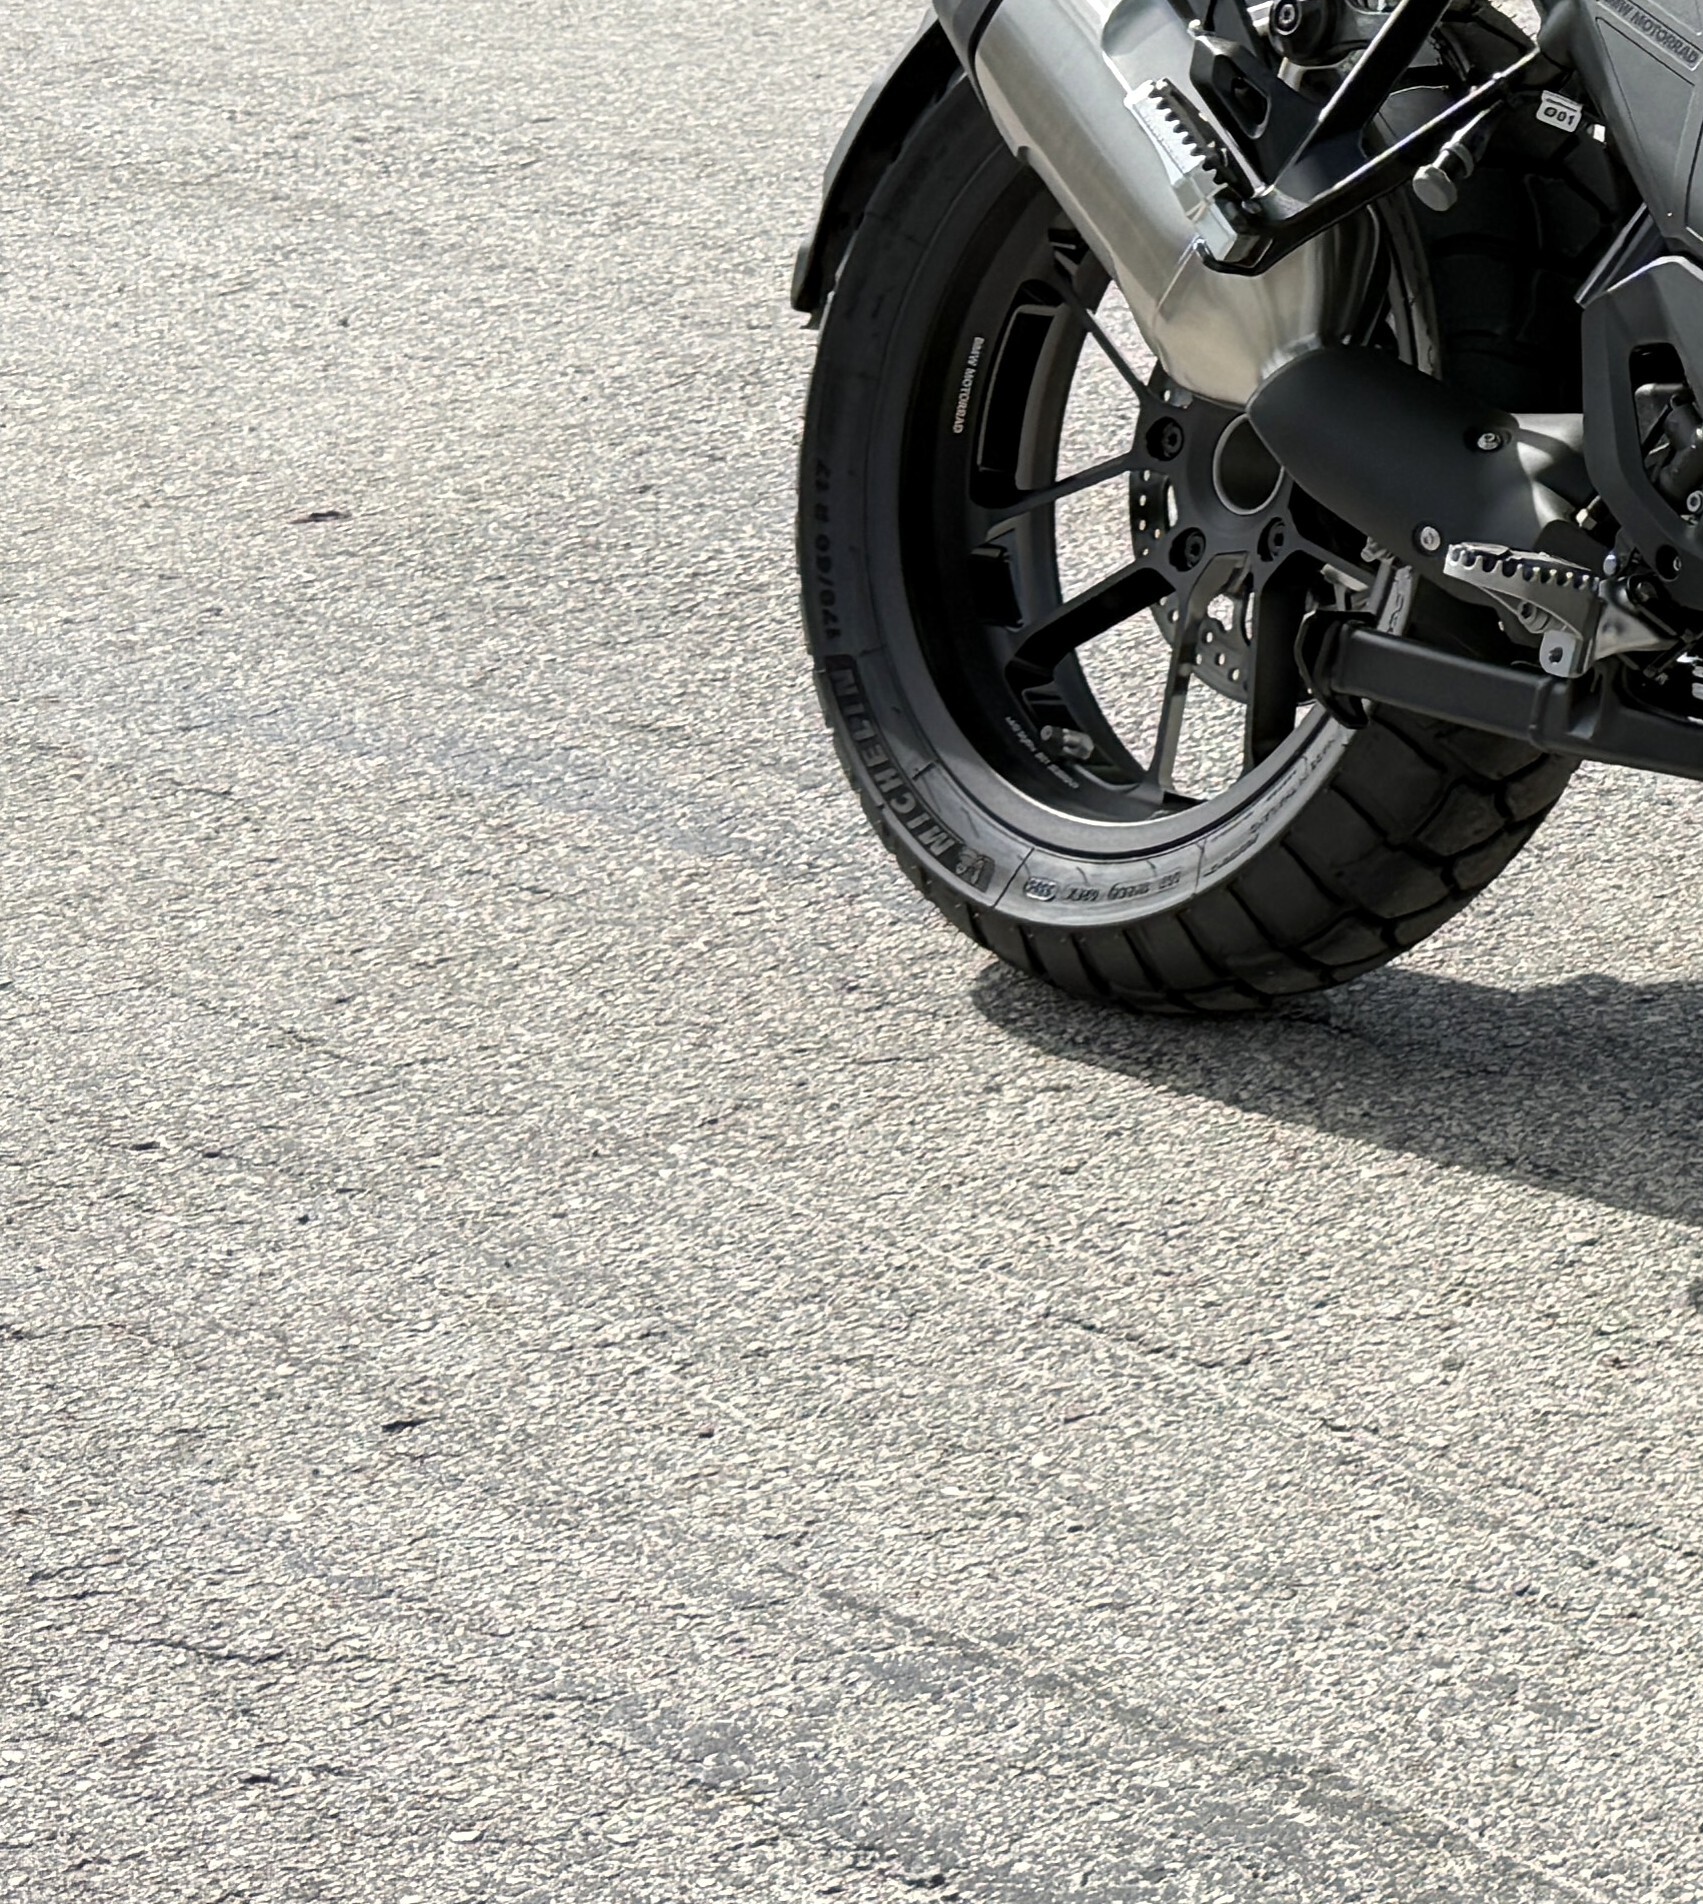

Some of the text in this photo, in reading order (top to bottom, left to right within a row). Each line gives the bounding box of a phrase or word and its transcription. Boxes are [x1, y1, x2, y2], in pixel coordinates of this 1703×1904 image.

[1629, 8, 1699, 65] MOTORRAD
[952, 336, 985, 434] BMW MOTORRAD
[830, 668, 957, 861] MICHELIN
